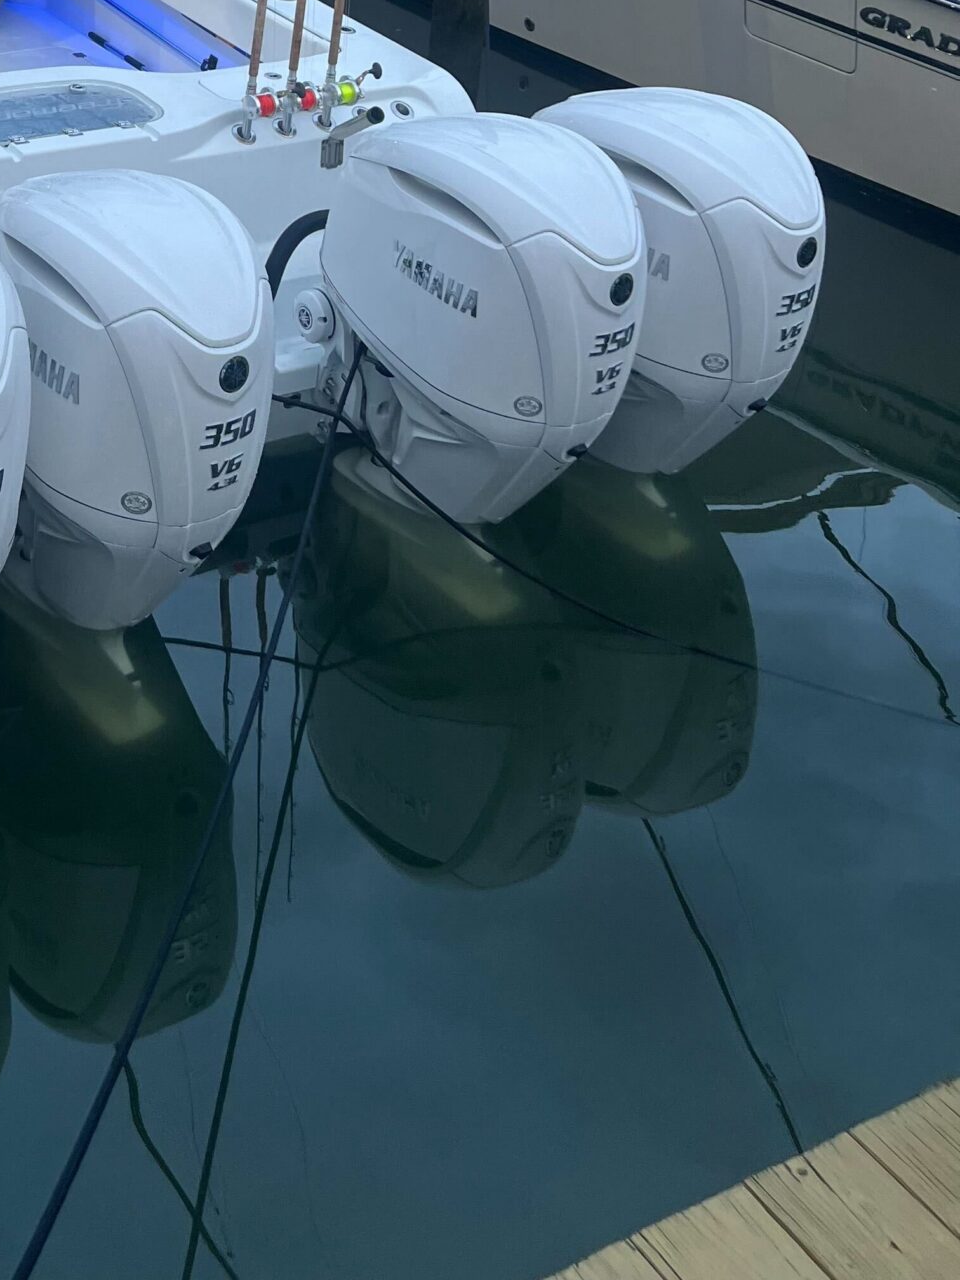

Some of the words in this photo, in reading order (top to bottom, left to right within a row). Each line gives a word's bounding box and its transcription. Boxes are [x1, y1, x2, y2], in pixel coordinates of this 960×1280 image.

[860, 6, 960, 56] GRAD
[394, 238, 479, 319] YAMAHA
[774, 283, 816, 316] 350
[588, 321, 636, 357] 350
[780, 320, 805, 341] V6
[596, 361, 624, 384] V6
[199, 407, 257, 450] 350
[210, 452, 244, 479] V6
